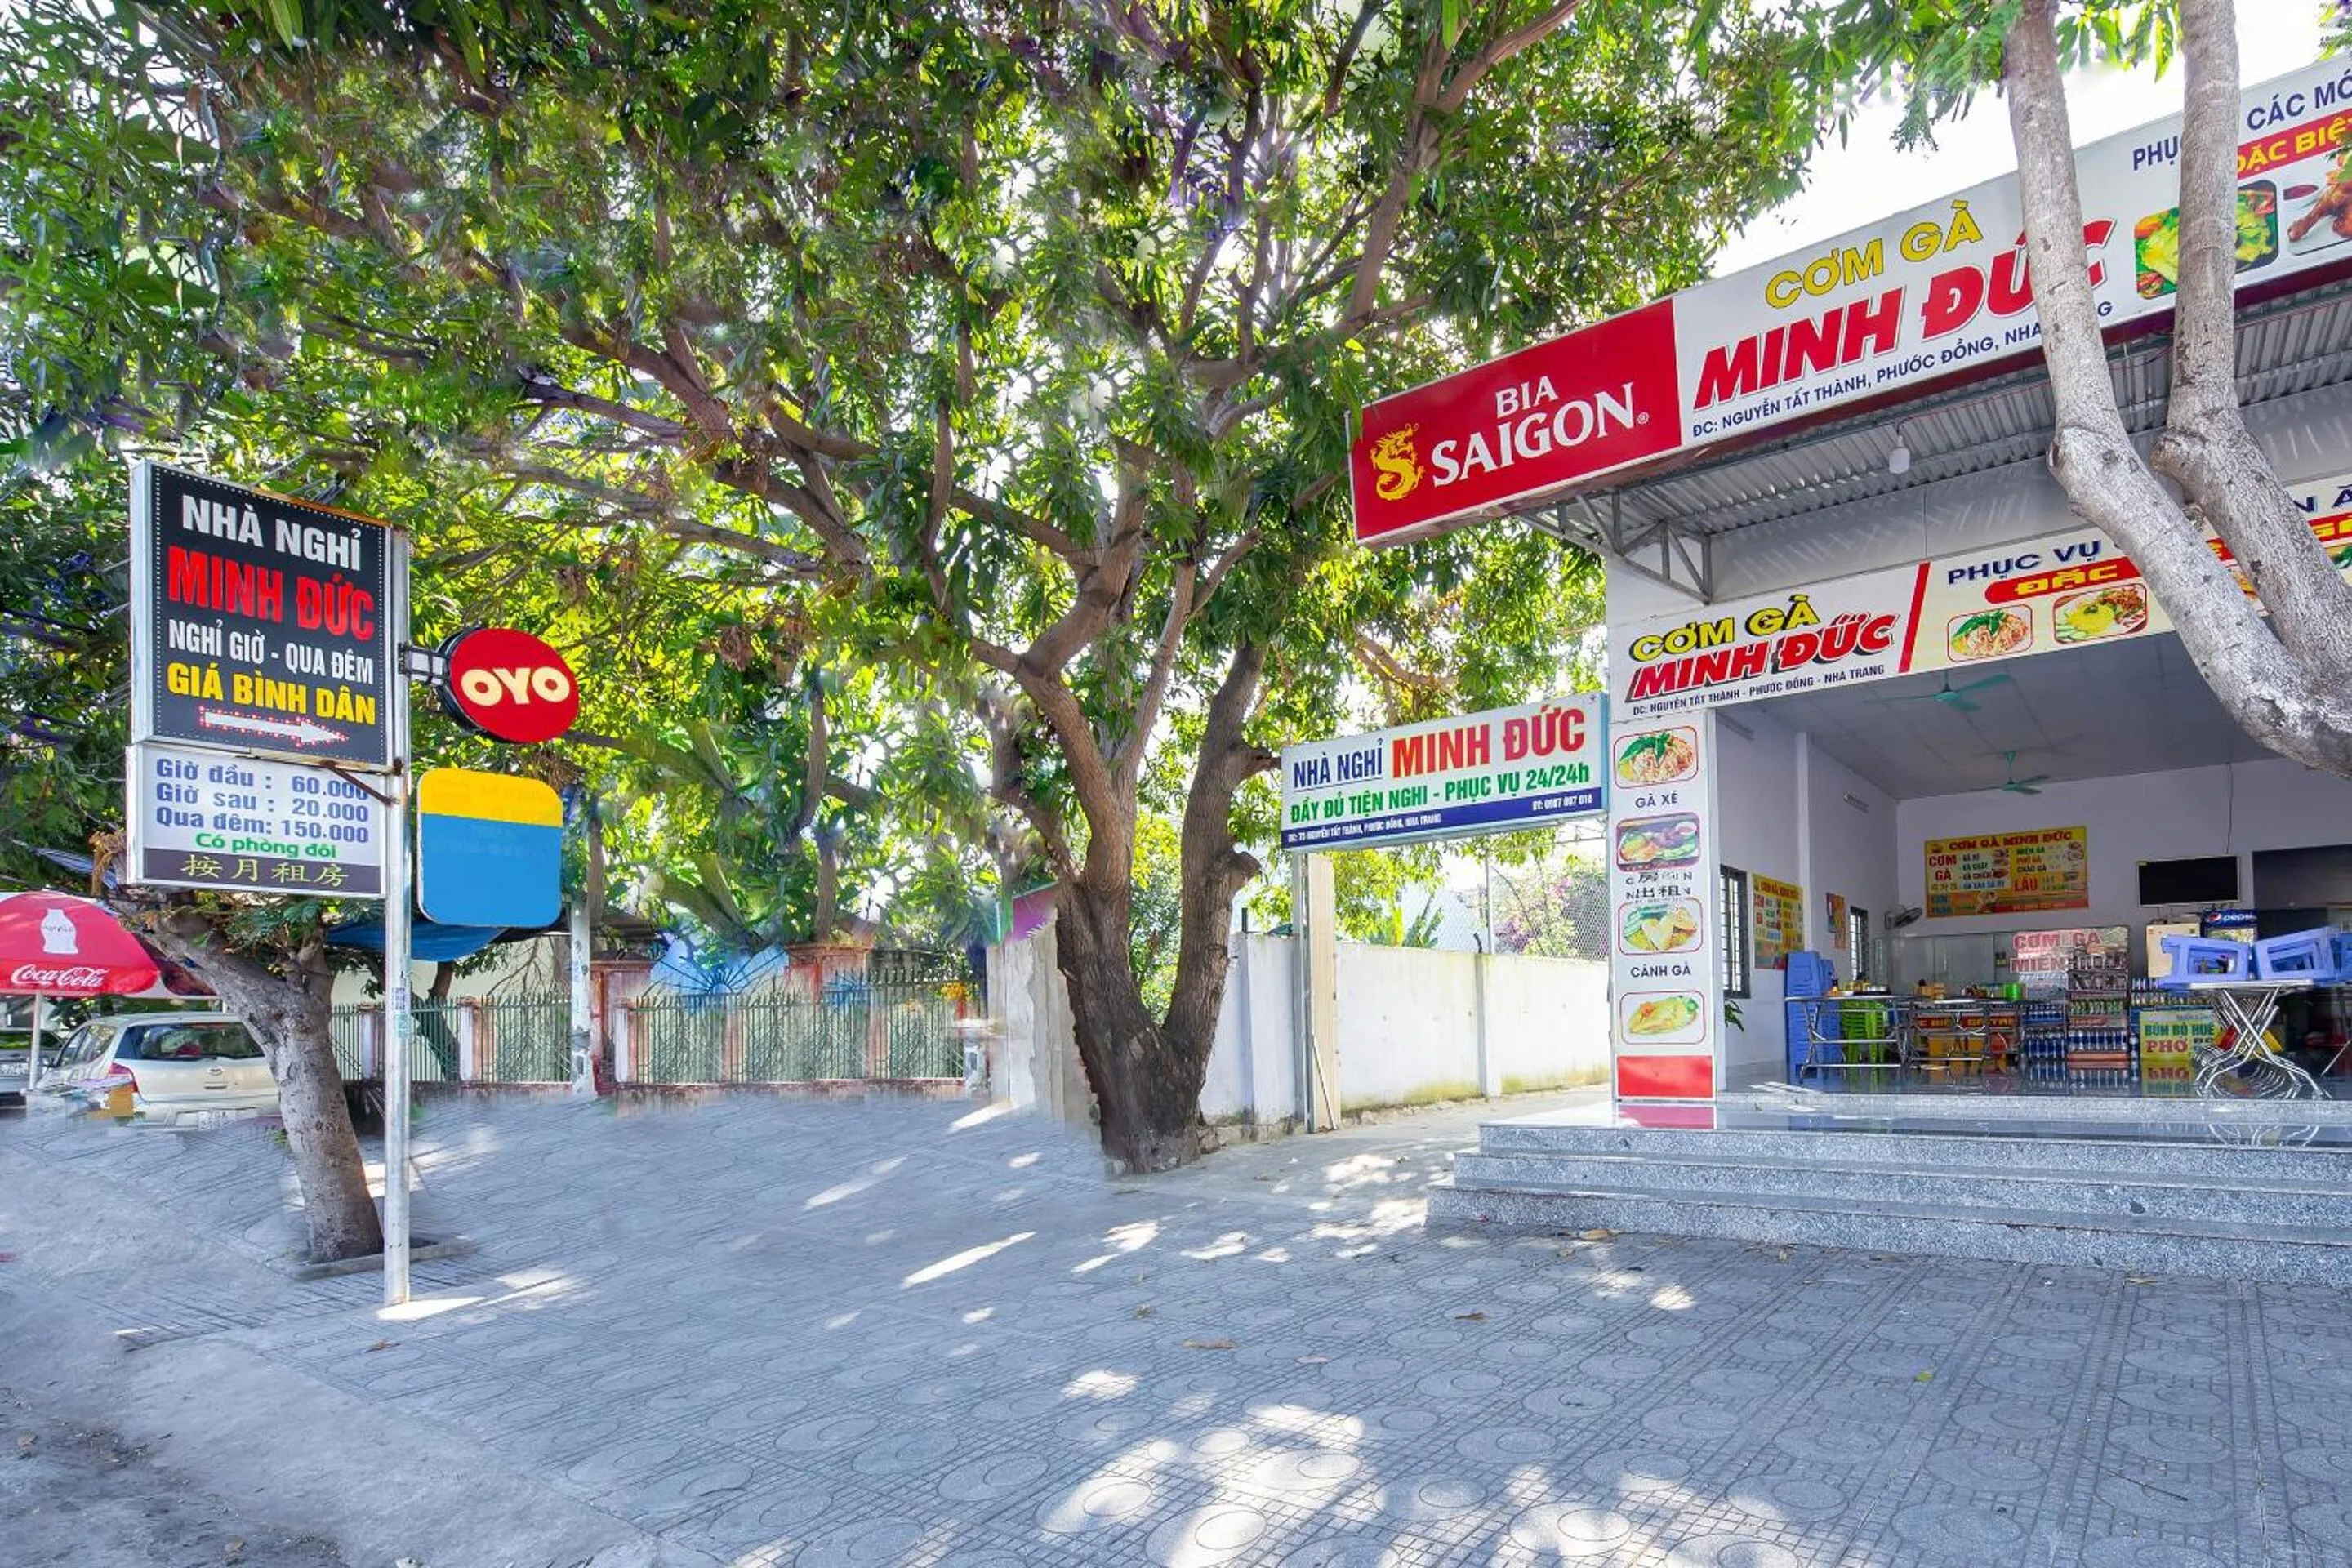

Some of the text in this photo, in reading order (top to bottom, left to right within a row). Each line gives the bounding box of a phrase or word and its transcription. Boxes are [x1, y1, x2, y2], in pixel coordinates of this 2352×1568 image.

[2133, 69, 2352, 171] PHỤ CÁC MÓ
[1766, 201, 1984, 309] CƠM GÀ
[1694, 286, 1906, 410] MINH
[1722, 399, 1780, 429] NGUYỄN
[1784, 387, 1811, 411] TẤT
[1814, 375, 1872, 401] THÀNH,
[1877, 353, 1936, 383] PHƯỚC
[2005, 321, 2042, 345] NHA
[1495, 376, 1559, 418] BIA
[1431, 381, 1634, 488] SAIGON
[182, 494, 361, 571] NHÀ NGHỈ
[1949, 554, 2041, 586] PHỤC
[2053, 540, 2102, 562] VỤ
[167, 545, 374, 641] MINH ĐỨC
[2015, 564, 2118, 595] ĐẶC
[168, 618, 223, 657] NGHỈ
[229, 629, 265, 664] GIỜ
[286, 642, 326, 676] QUA
[330, 648, 374, 684] ĐÊM
[1627, 613, 1900, 702] MINH ĐỨC
[1630, 595, 1820, 662] CƠM GÀ
[167, 662, 376, 725] GIÁ BÌNH DÂN
[461, 666, 570, 706] OYO
[1824, 669, 1846, 684] NHA
[1850, 663, 1884, 679] TRANG
[1294, 704, 1585, 788] NHÀ NGHỈ MINH ĐỨC
[156, 758, 198, 781] Giờ
[292, 775, 368, 801] 60.000
[156, 782, 198, 804] Giờ
[213, 792, 256, 810] sau
[292, 798, 368, 822] 20.000
[1349, 790, 1383, 817] TIỆN
[1445, 777, 1492, 806] PHỤC
[1498, 773, 1521, 797] VỤ
[1526, 761, 1590, 789] 24/24h
[156, 806, 204, 829] Qua
[280, 819, 368, 843] 150.000
[196, 833, 226, 849] Có
[305, 844, 336, 858] đôi
[11, 964, 110, 987] Coca-Cola
